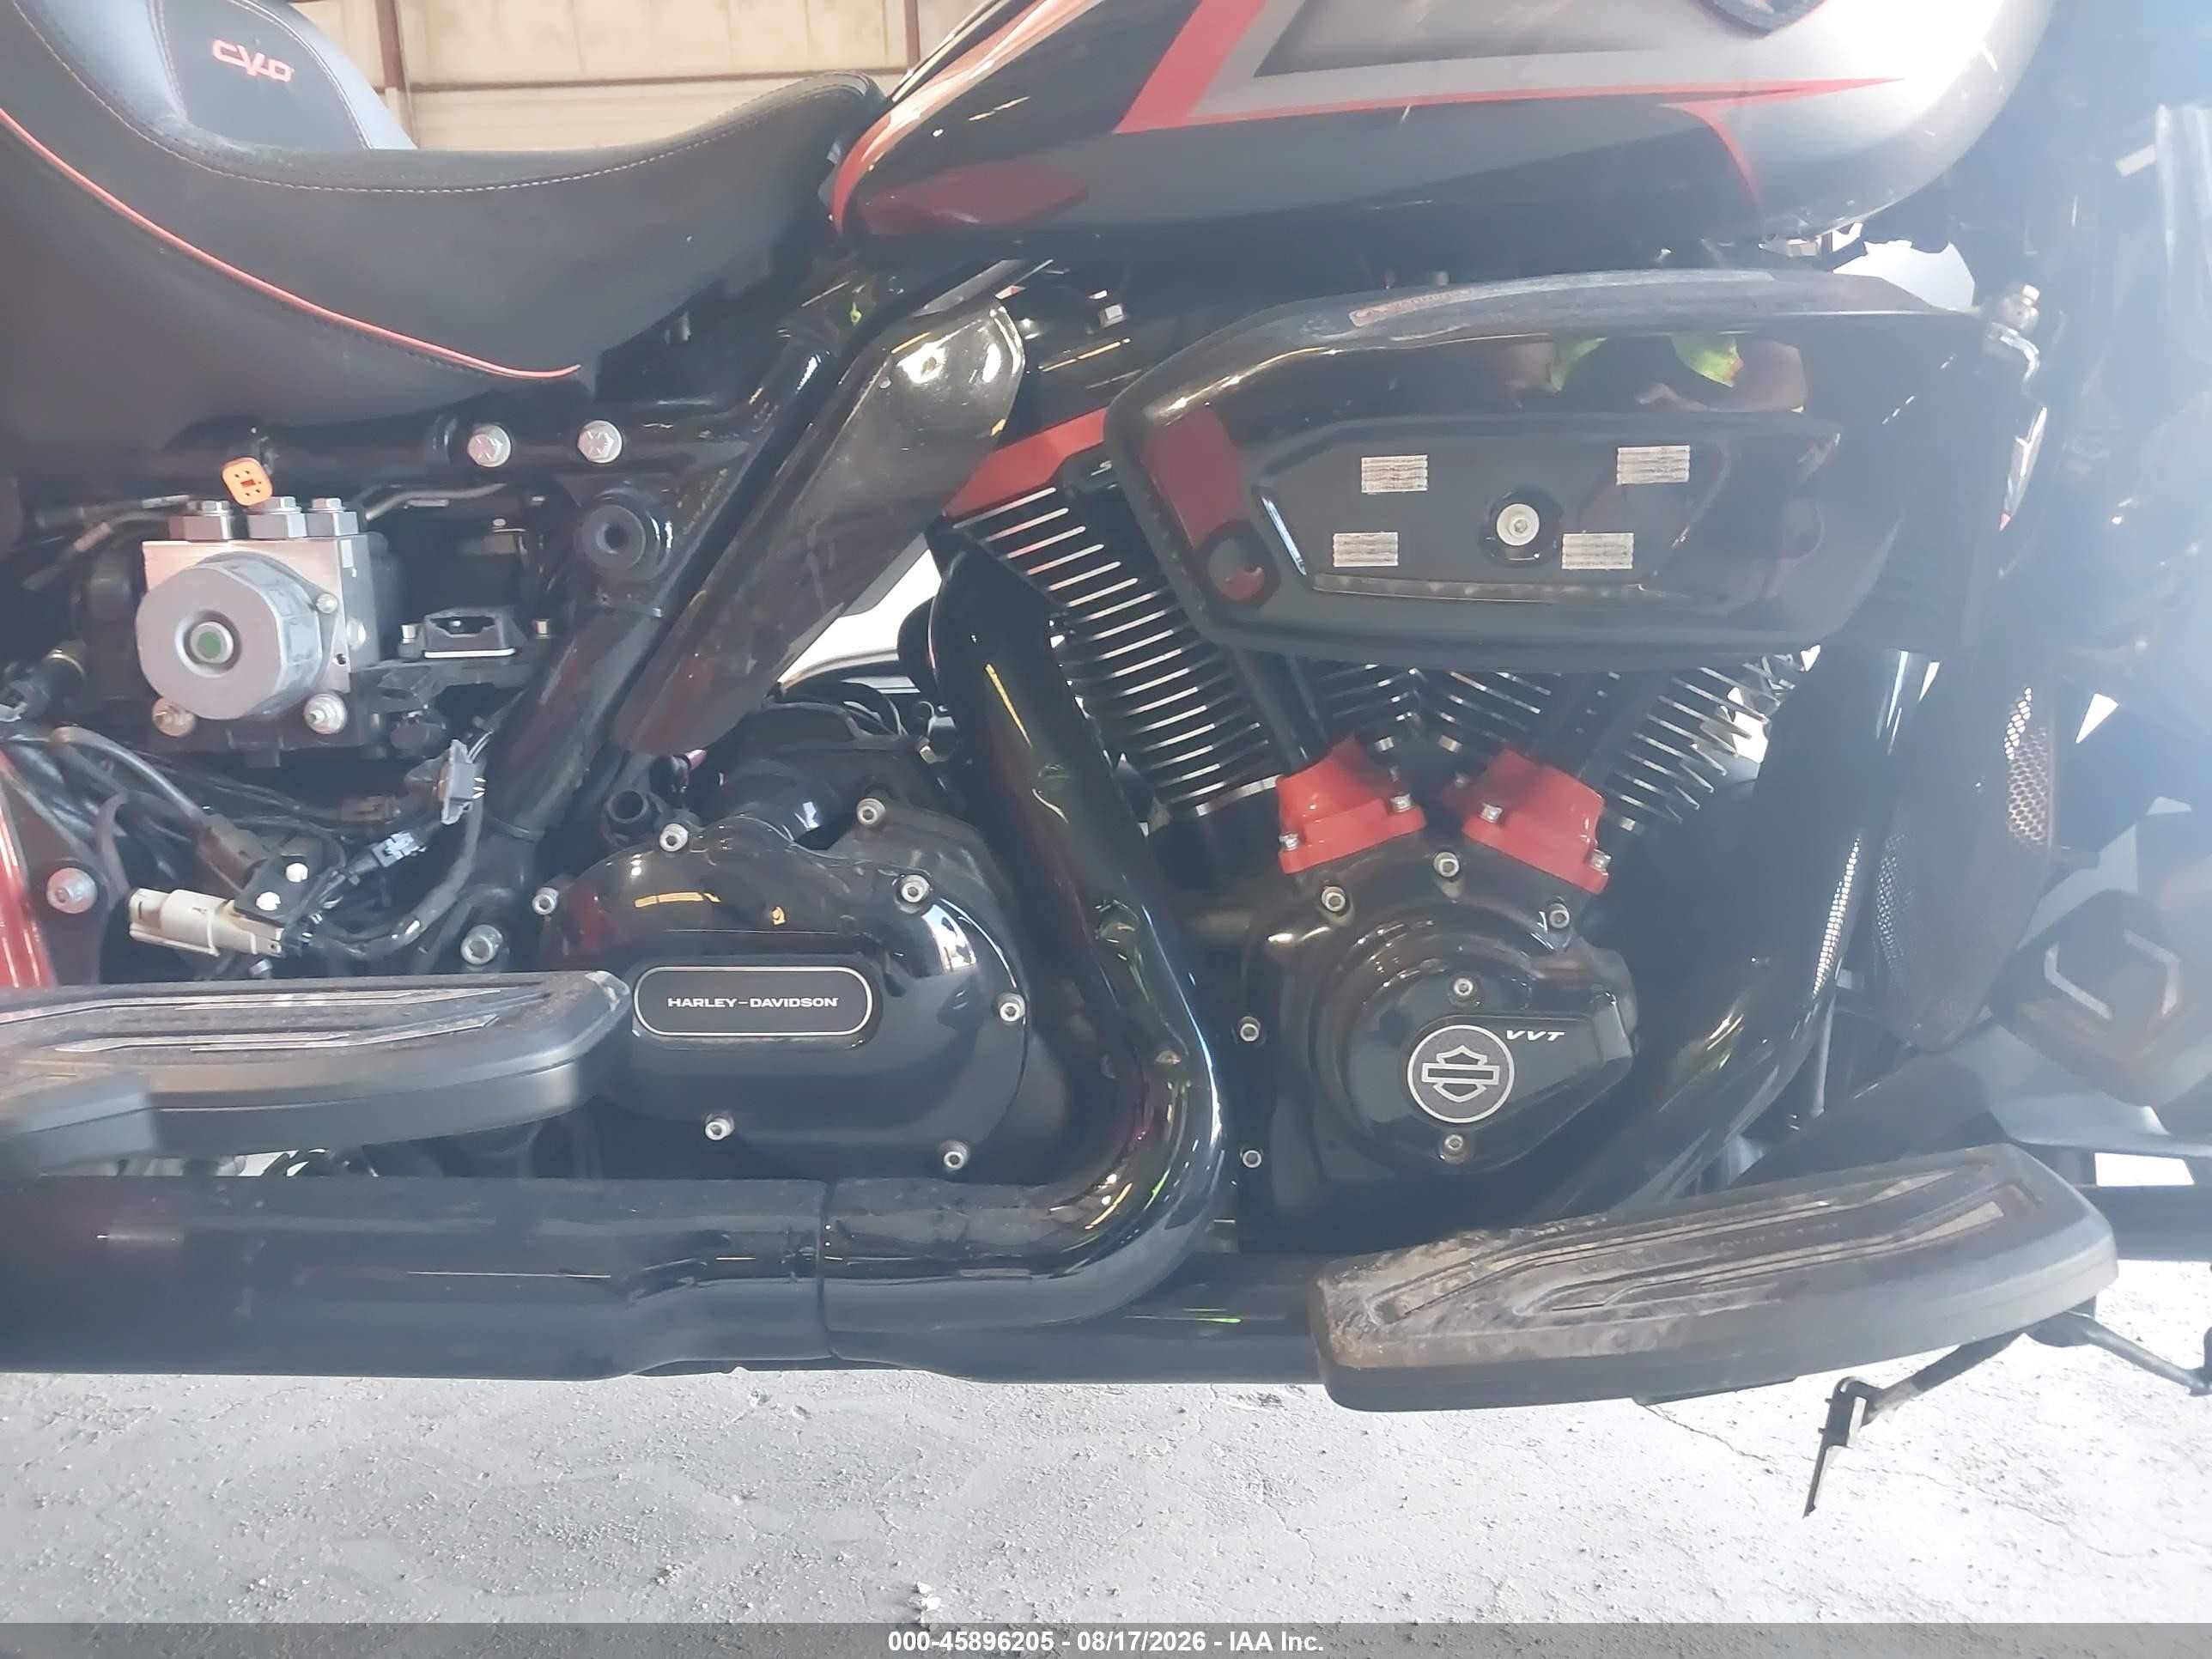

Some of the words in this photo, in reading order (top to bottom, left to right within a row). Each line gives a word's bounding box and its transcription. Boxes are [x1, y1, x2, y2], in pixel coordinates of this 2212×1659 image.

[212, 40, 293, 82] CVO
[667, 997, 839, 1008] HARLEY-DAVIDSON
[1506, 1030, 1565, 1042] VVT
